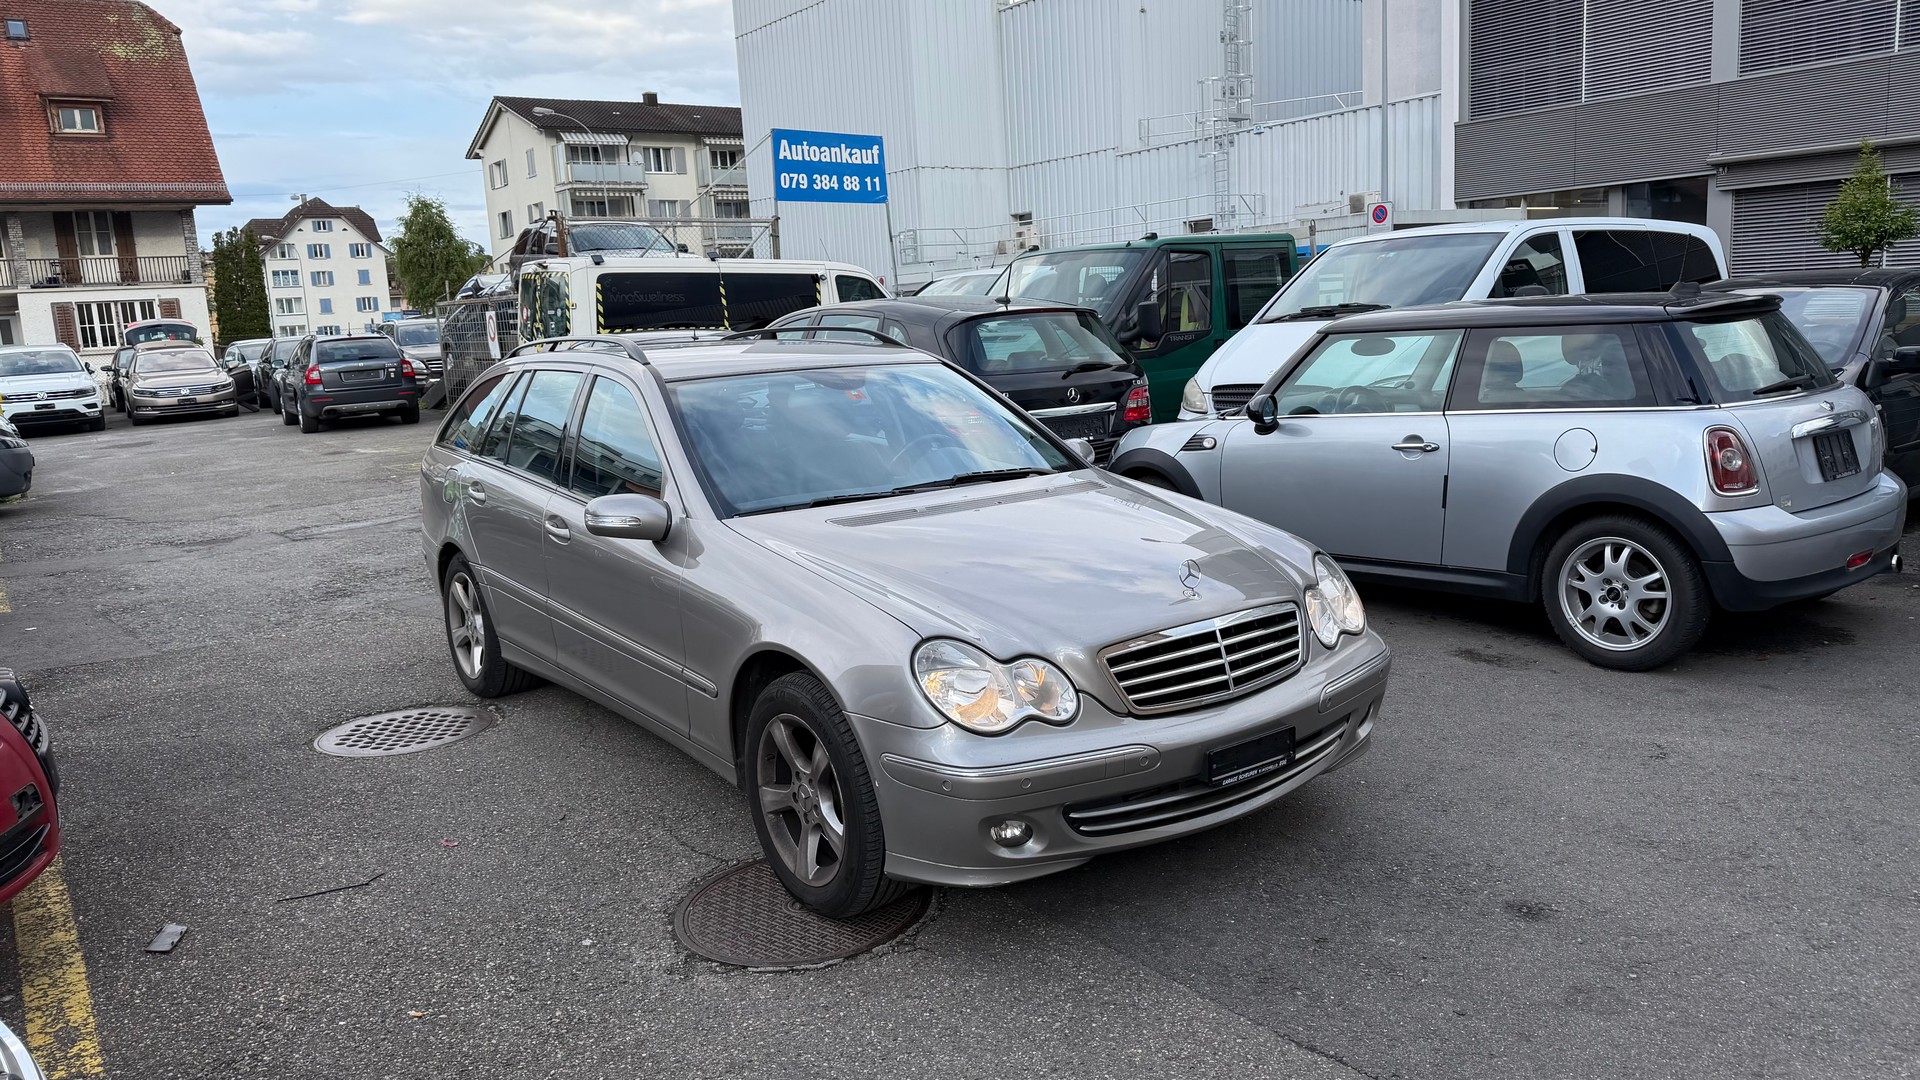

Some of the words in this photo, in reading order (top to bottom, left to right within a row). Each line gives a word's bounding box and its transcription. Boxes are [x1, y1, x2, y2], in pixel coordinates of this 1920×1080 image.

[779, 139, 879, 164] Autoankauf
[780, 173, 808, 189] 079
[812, 174, 839, 190] 384
[843, 176, 861, 191] 88
[865, 176, 881, 191] 11
[608, 291, 686, 305] iving&wellness
